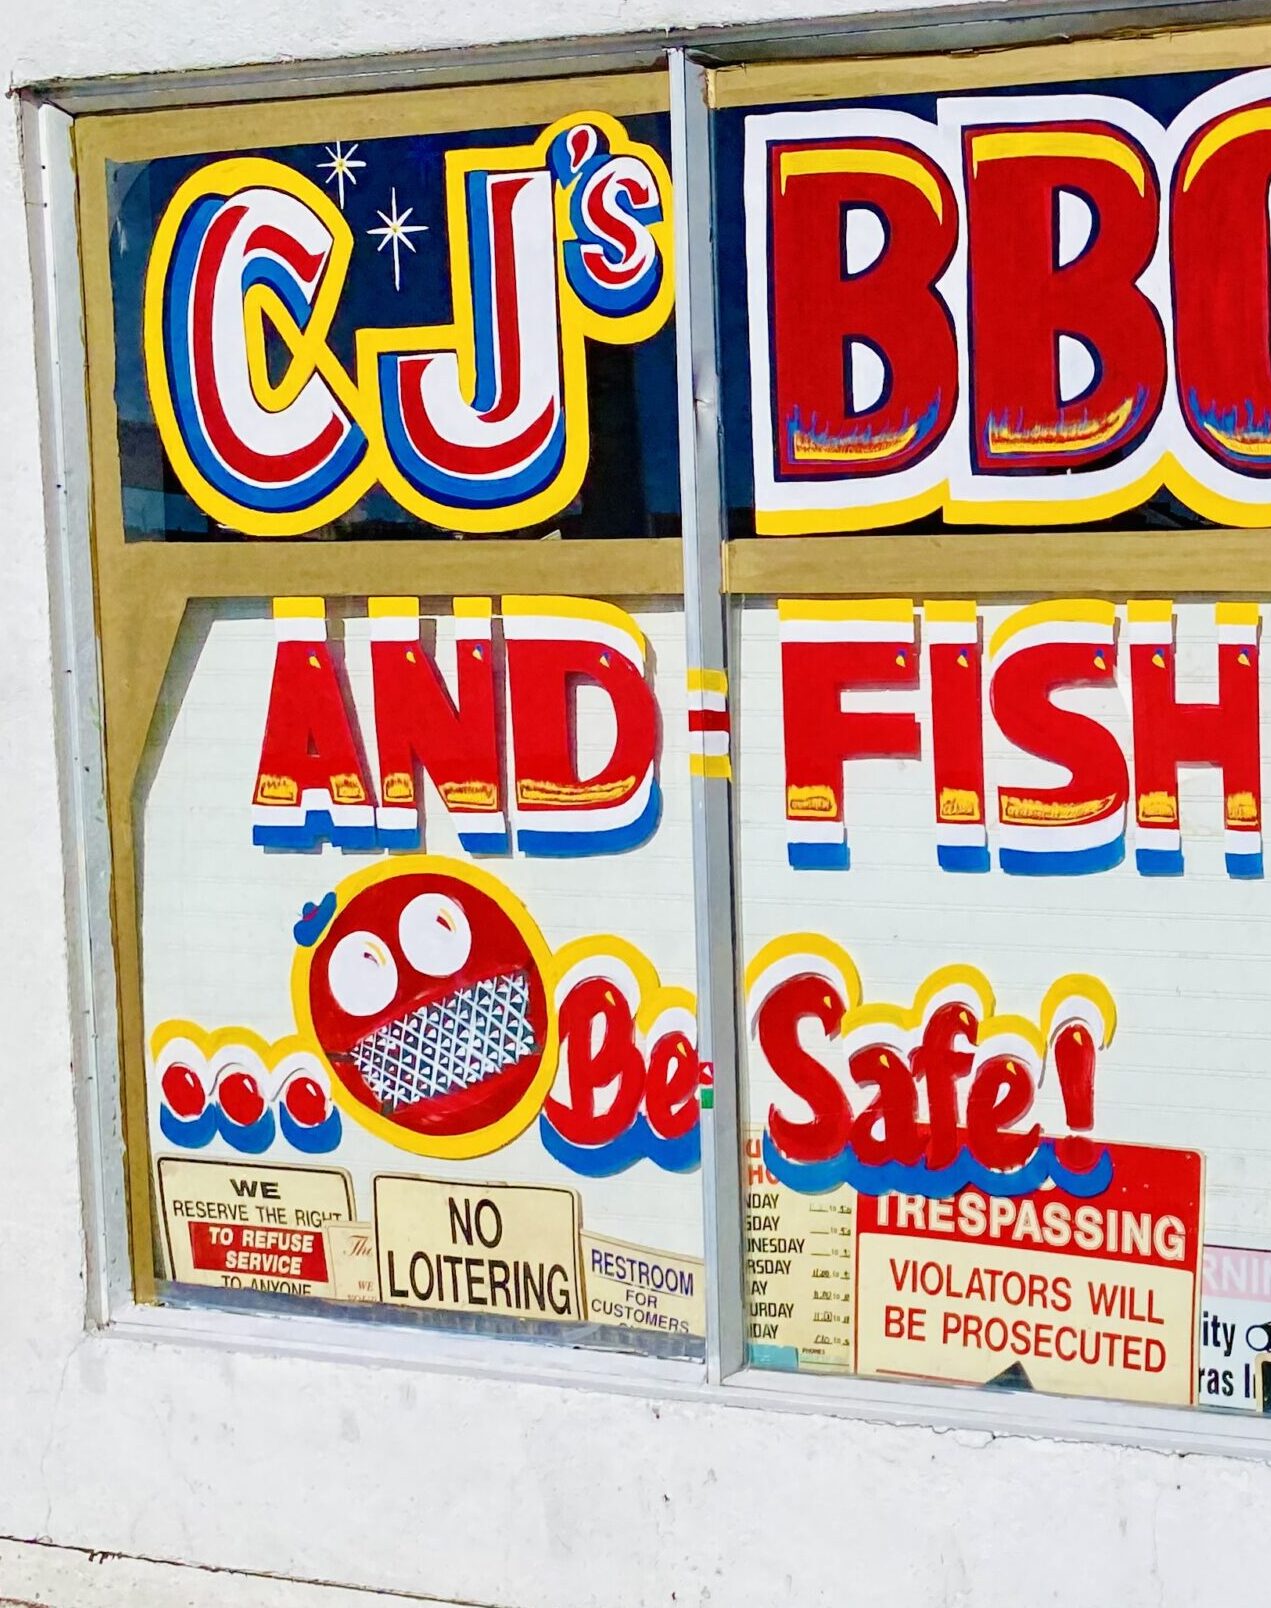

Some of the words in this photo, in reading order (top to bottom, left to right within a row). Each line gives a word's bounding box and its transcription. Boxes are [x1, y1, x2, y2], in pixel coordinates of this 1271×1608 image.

[152, 117, 672, 522] CJ's
[252, 600, 661, 850] AND
[778, 602, 1262, 868] FISH
[545, 955, 701, 1160] Be
[750, 948, 1105, 1183] Safe!
[173, 1200, 249, 1221] RESERVE
[256, 1206, 287, 1225] THE
[230, 1178, 281, 1199] WE
[209, 1226, 233, 1246] TO
[242, 1230, 314, 1253] REFUSE
[449, 1197, 502, 1248] NO
[225, 1251, 302, 1275] SERVICE
[388, 1250, 571, 1315] LOITERING
[591, 1248, 694, 1297] RESTROOM
[591, 1299, 689, 1333] CUSTOMERS
[626, 1289, 657, 1309] FOR
[889, 1258, 1072, 1312] VIOLATORS
[1088, 1281, 1164, 1324] WILL
[885, 1305, 926, 1341] BE
[943, 1312, 1166, 1374] PROSECUTED
